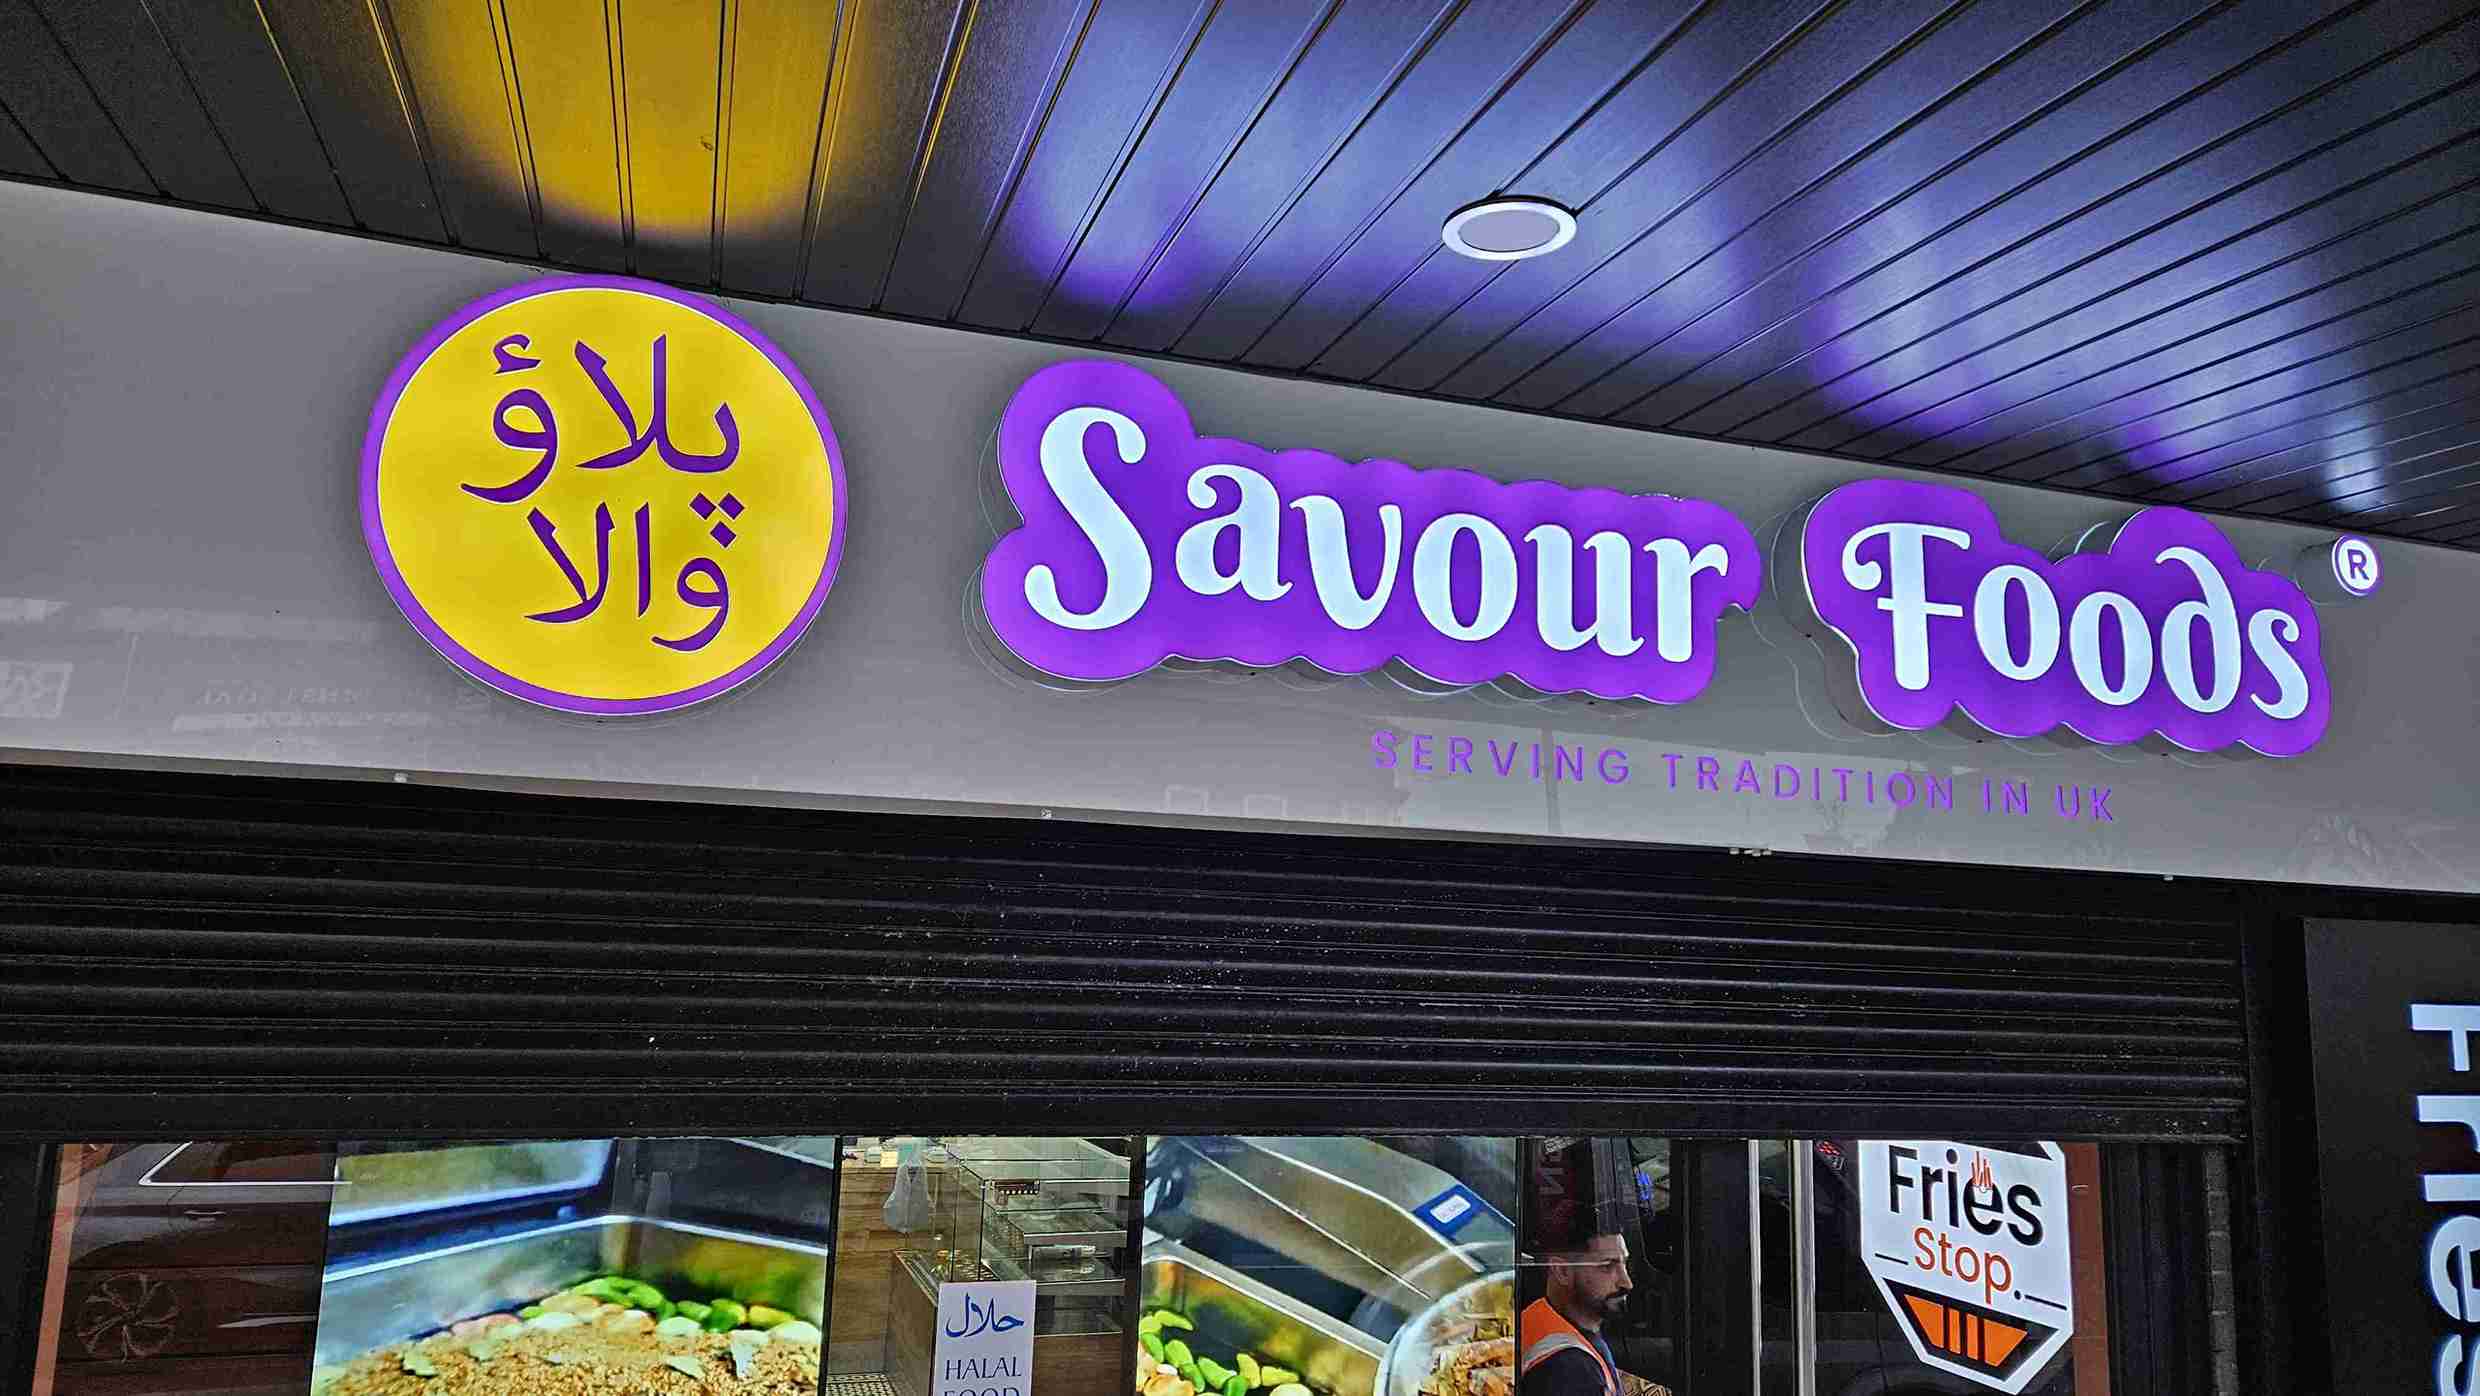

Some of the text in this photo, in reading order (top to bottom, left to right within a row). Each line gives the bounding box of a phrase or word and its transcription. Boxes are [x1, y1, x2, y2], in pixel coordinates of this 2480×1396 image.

[524, 501, 731, 652] والا
[1024, 406, 2310, 719] Savour Foods
[1371, 730, 2114, 823] SERVING TRADITION IN UK
[1889, 1145, 2043, 1246] Fries
[945, 1291, 1025, 1338] حلال
[944, 1357, 1022, 1381] HALAL
